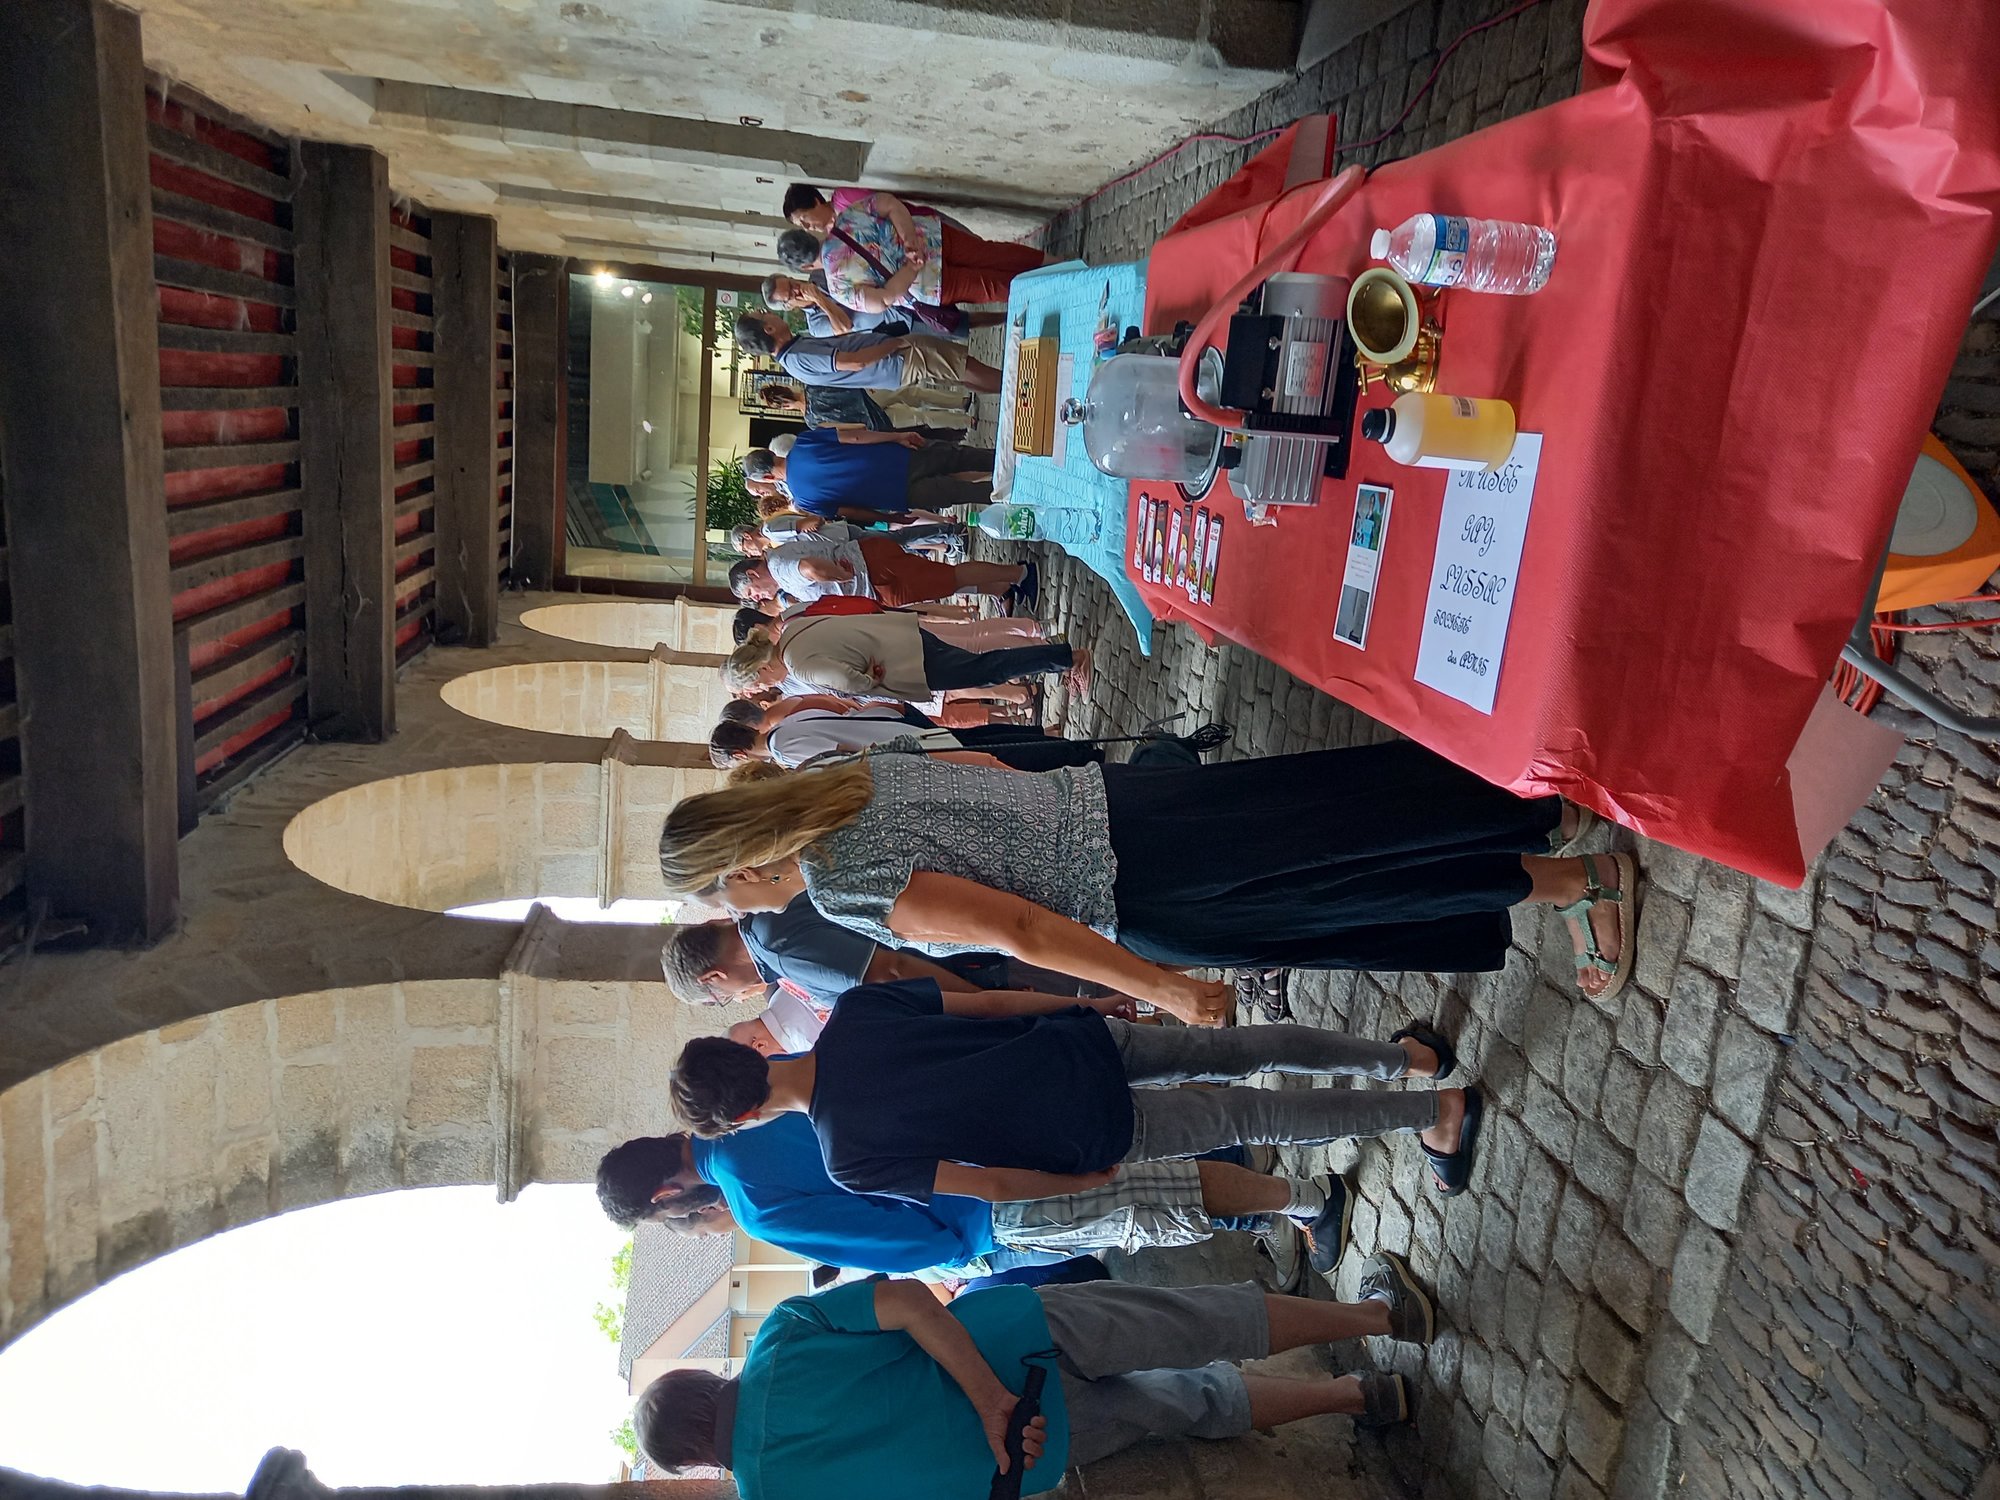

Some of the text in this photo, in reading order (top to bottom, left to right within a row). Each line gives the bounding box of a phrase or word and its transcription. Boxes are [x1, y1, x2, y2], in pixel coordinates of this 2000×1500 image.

[1016, 508, 1029, 540] Volvic
[1439, 563, 1507, 605] LUSSAC
[1433, 608, 1472, 634] SOCIÉTÉ
[1447, 650, 1489, 676] des AMIS
